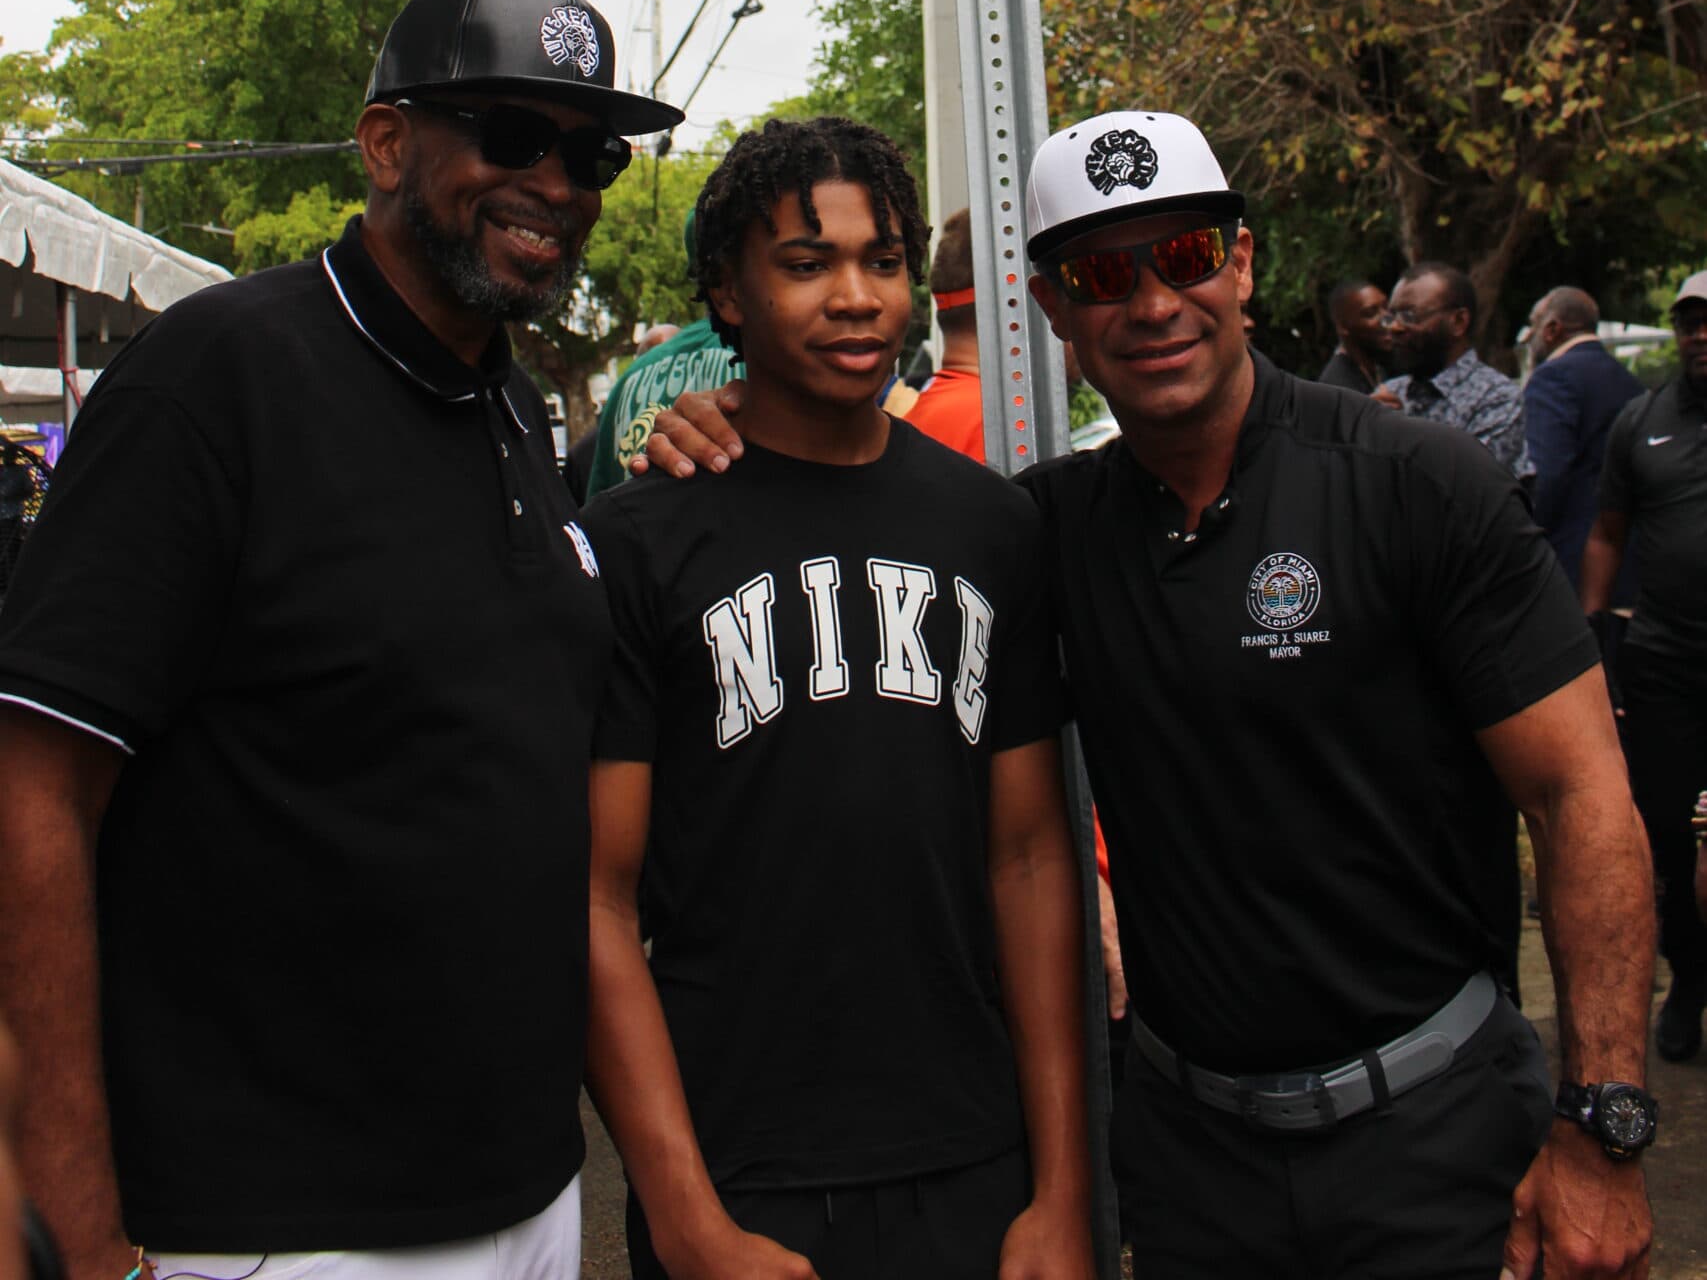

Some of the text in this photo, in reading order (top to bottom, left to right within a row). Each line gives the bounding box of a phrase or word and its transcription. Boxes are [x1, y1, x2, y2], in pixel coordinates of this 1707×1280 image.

[1251, 564, 1267, 590] CITY
[1269, 556, 1285, 566] OF
[1288, 557, 1316, 584] MIAMI
[1260, 612, 1305, 626] FLORIDA
[1241, 633, 1278, 647] FRANCIS
[1294, 631, 1330, 643] SUAREZ
[703, 556, 994, 749] NIKE
[1269, 646, 1301, 659] MAYOR
